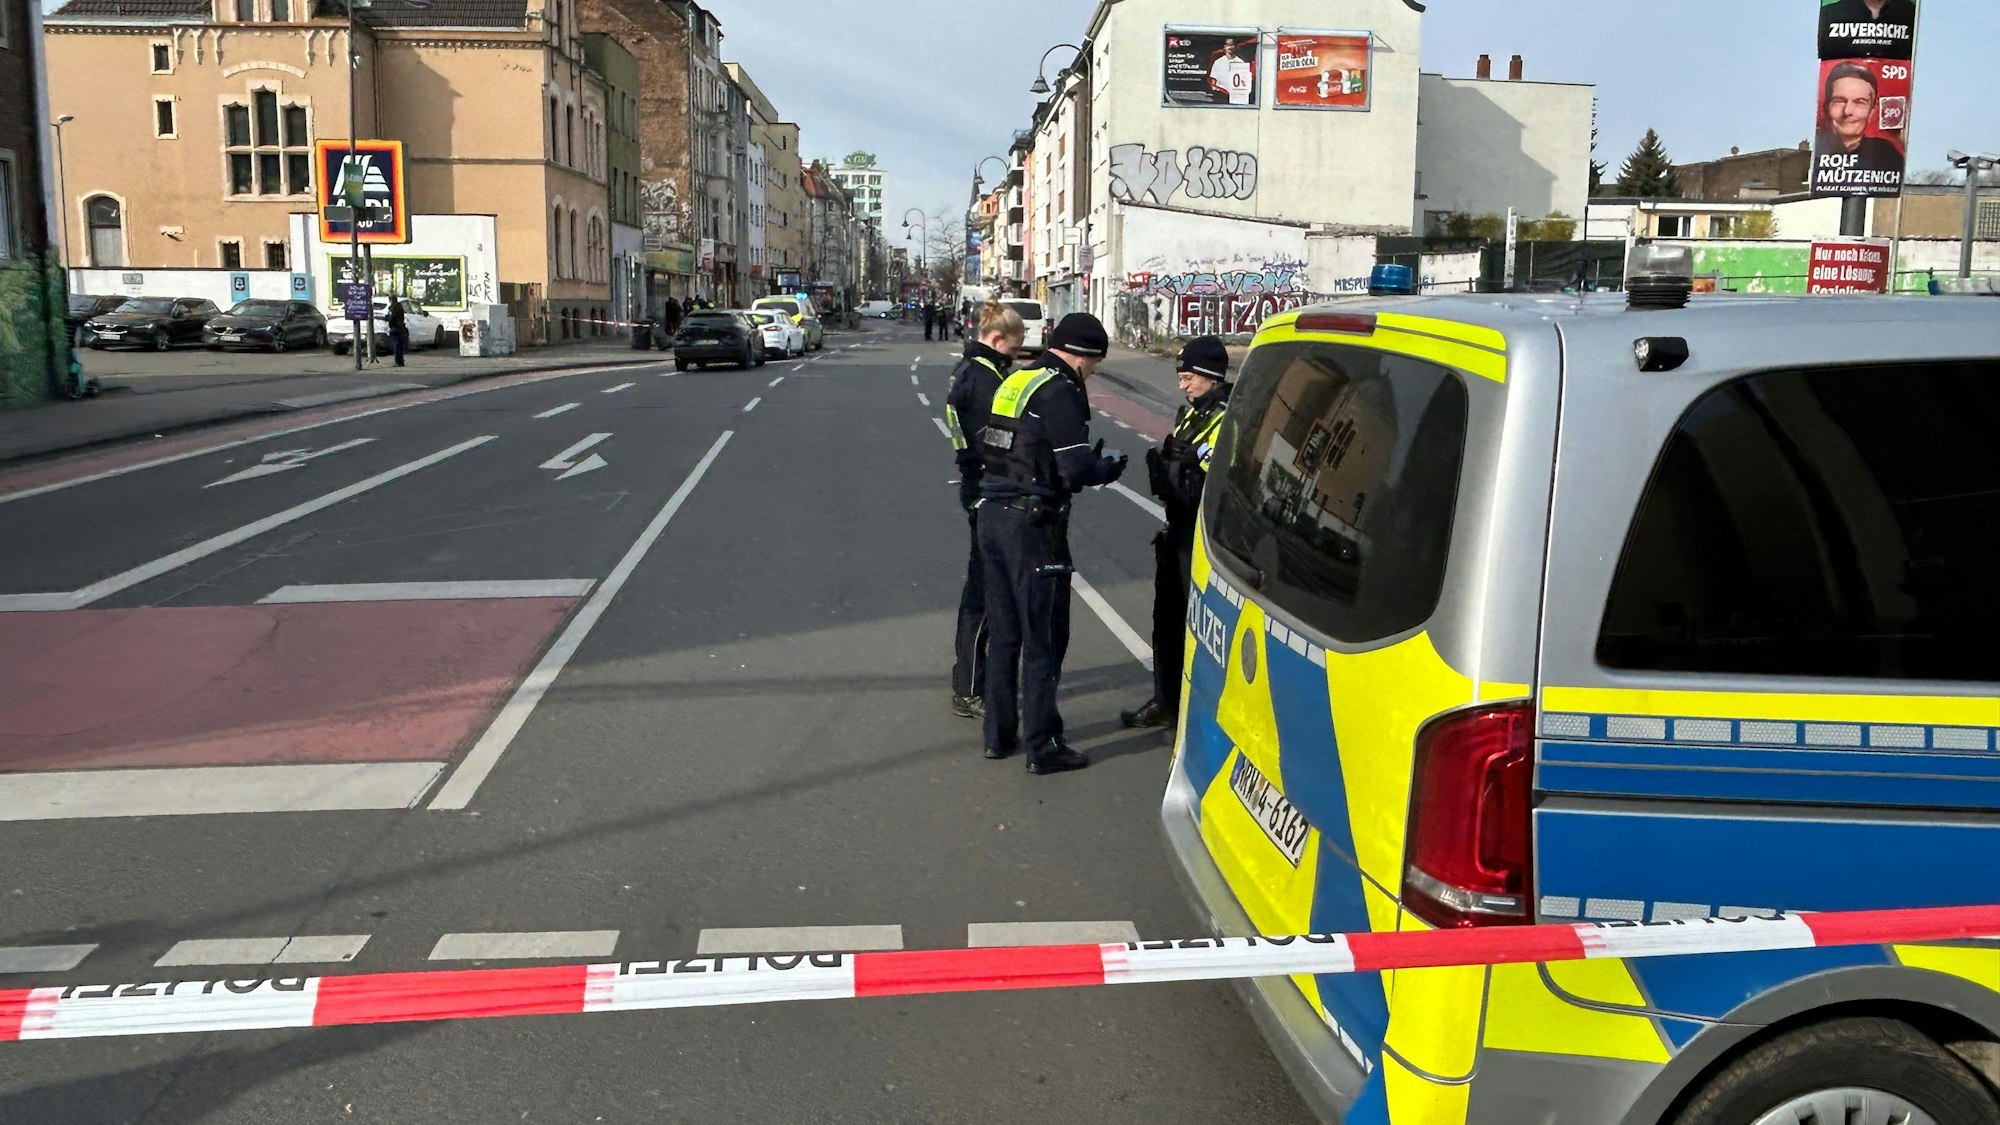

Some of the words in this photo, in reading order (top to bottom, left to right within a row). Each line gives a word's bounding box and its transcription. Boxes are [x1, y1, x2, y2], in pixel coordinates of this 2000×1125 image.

[1829, 23, 1910, 40] ZUVERSICHT.
[1882, 65, 1908, 79] SPD
[1820, 154, 1858, 168] ROLF
[1817, 167, 1900, 184] MÜTZENICH
[1815, 247, 1832, 261] Nur
[1834, 248, 1858, 262] noch
[1813, 264, 1838, 280] eine
